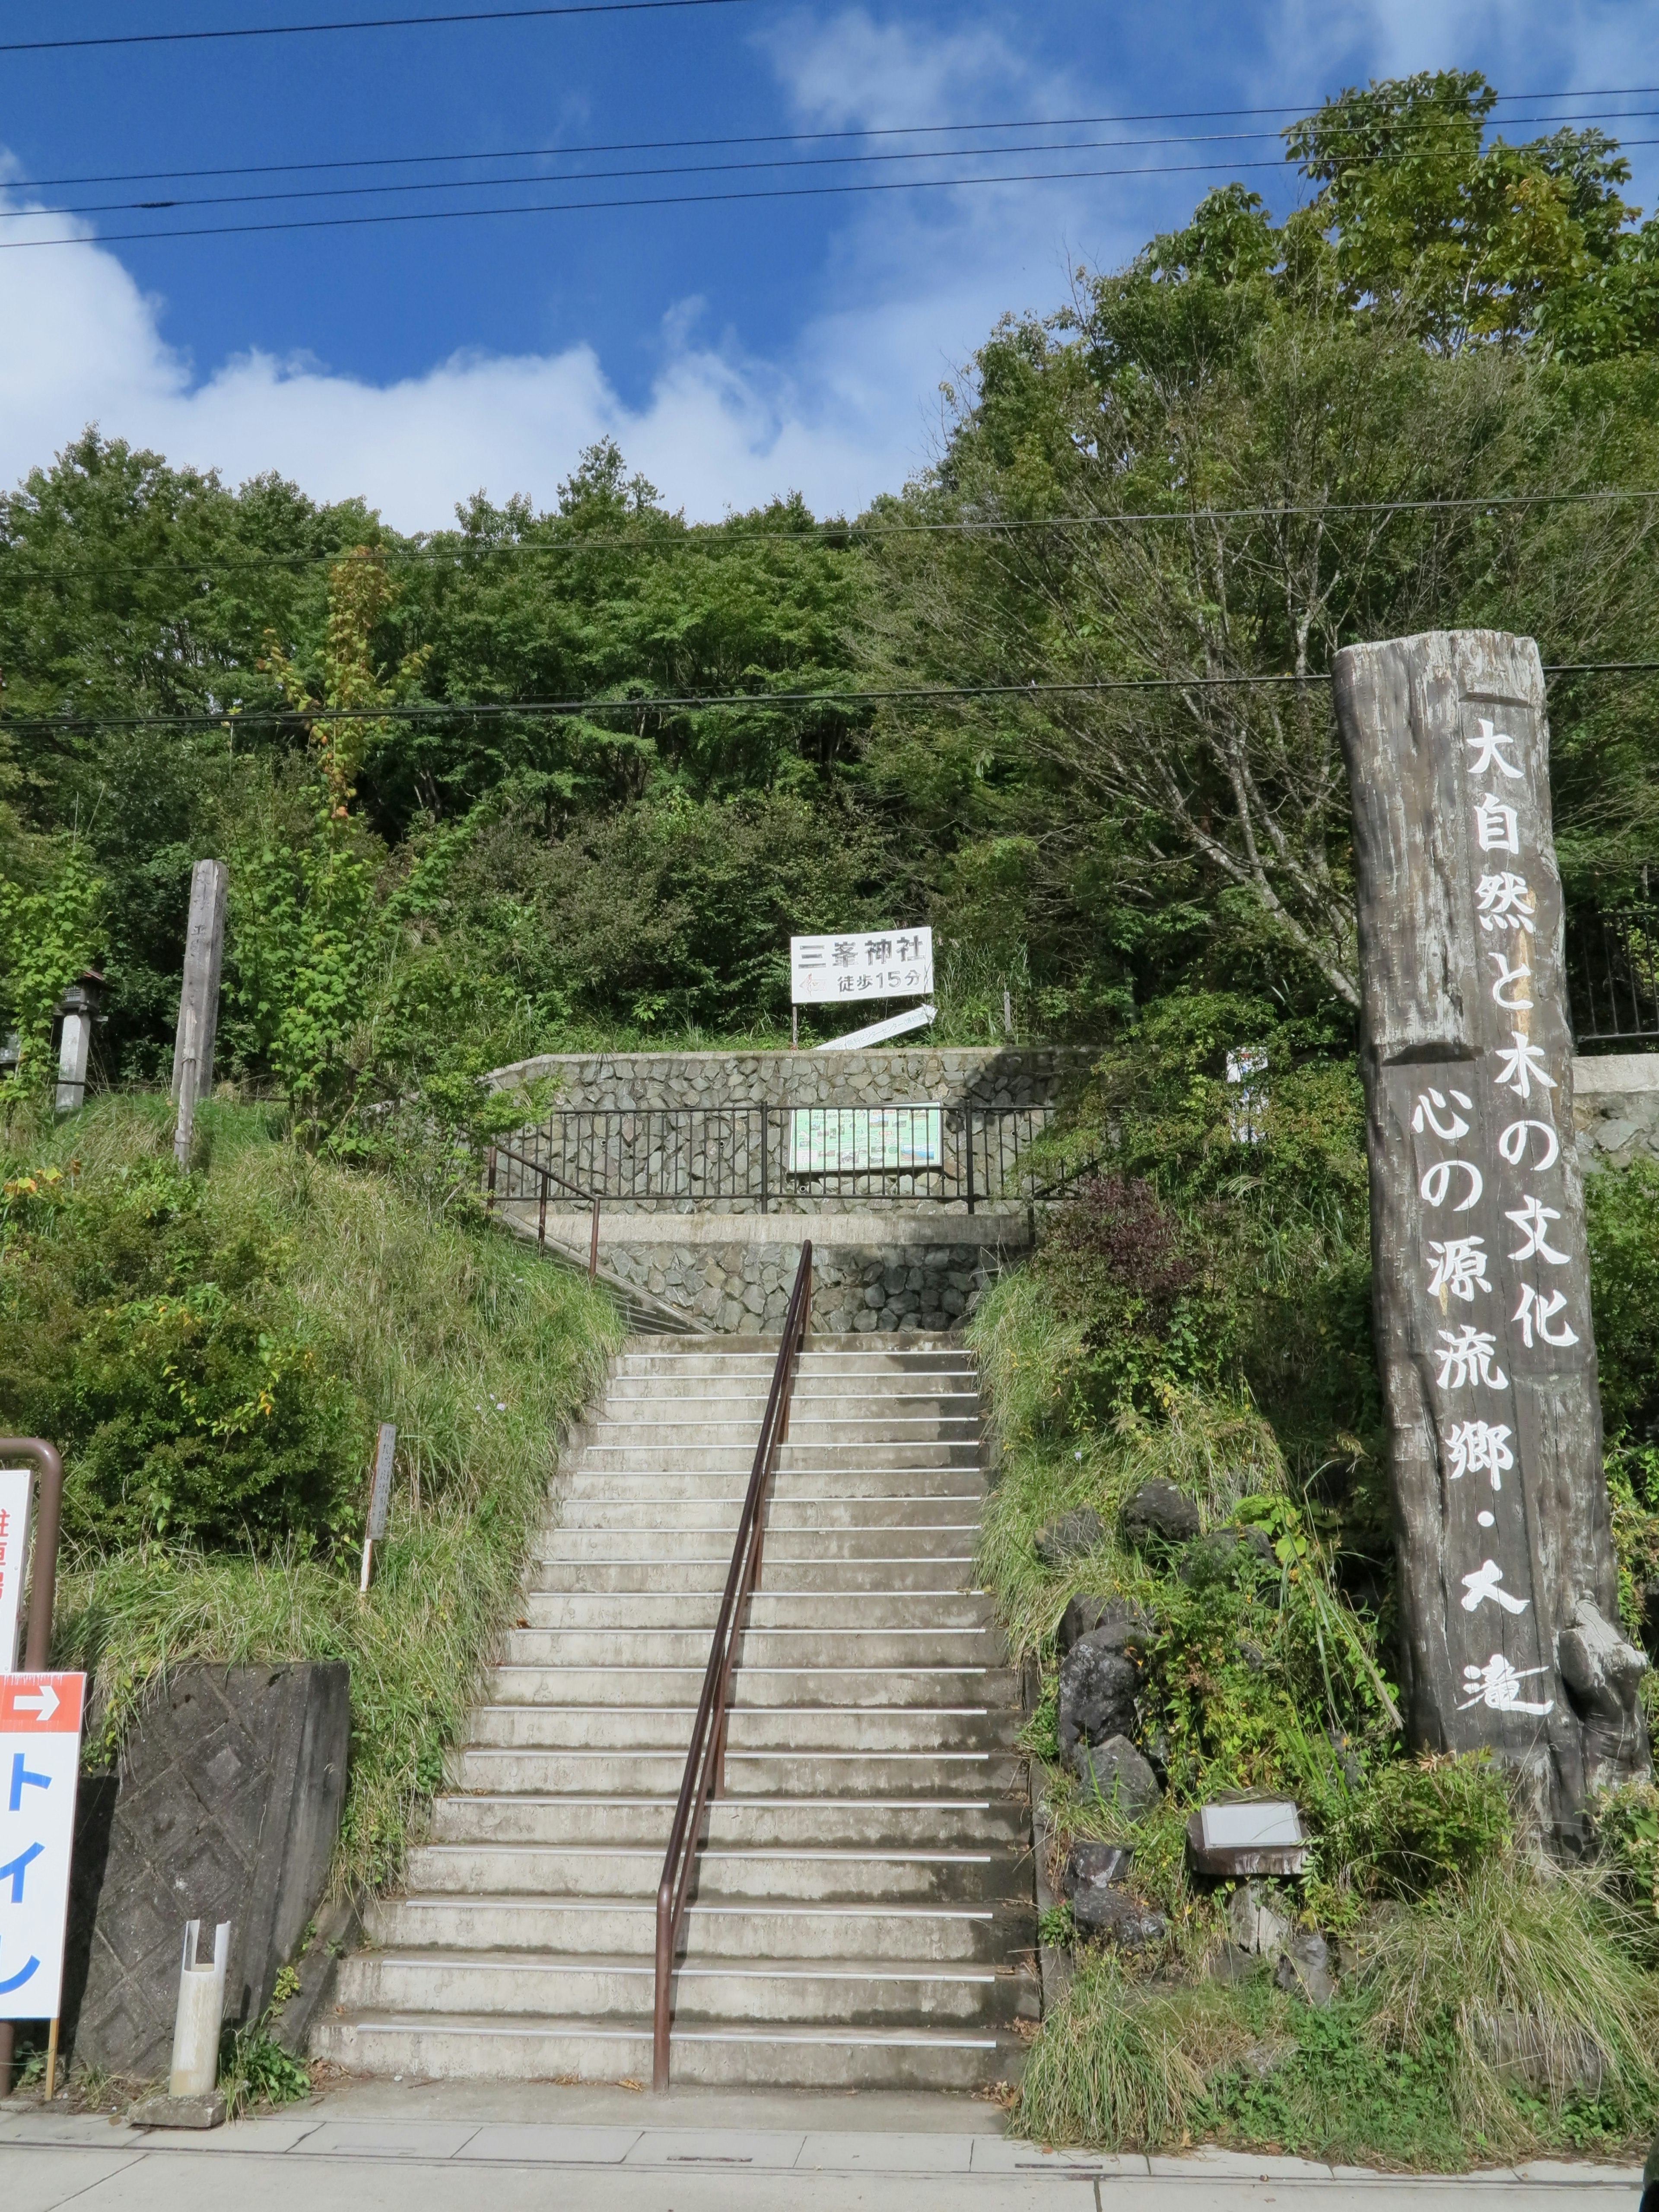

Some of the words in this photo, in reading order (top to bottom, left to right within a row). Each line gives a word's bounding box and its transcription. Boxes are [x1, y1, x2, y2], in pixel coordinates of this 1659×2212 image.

[798, 934, 925, 969] 三峯神社
[837, 969, 922, 993] 徒歩15分
[1466, 717, 1580, 1348] 大自然と木の文化
[1411, 1087, 1555, 1716] 心の源流郷・大滝
[0, 1752, 53, 1996] トイレ
